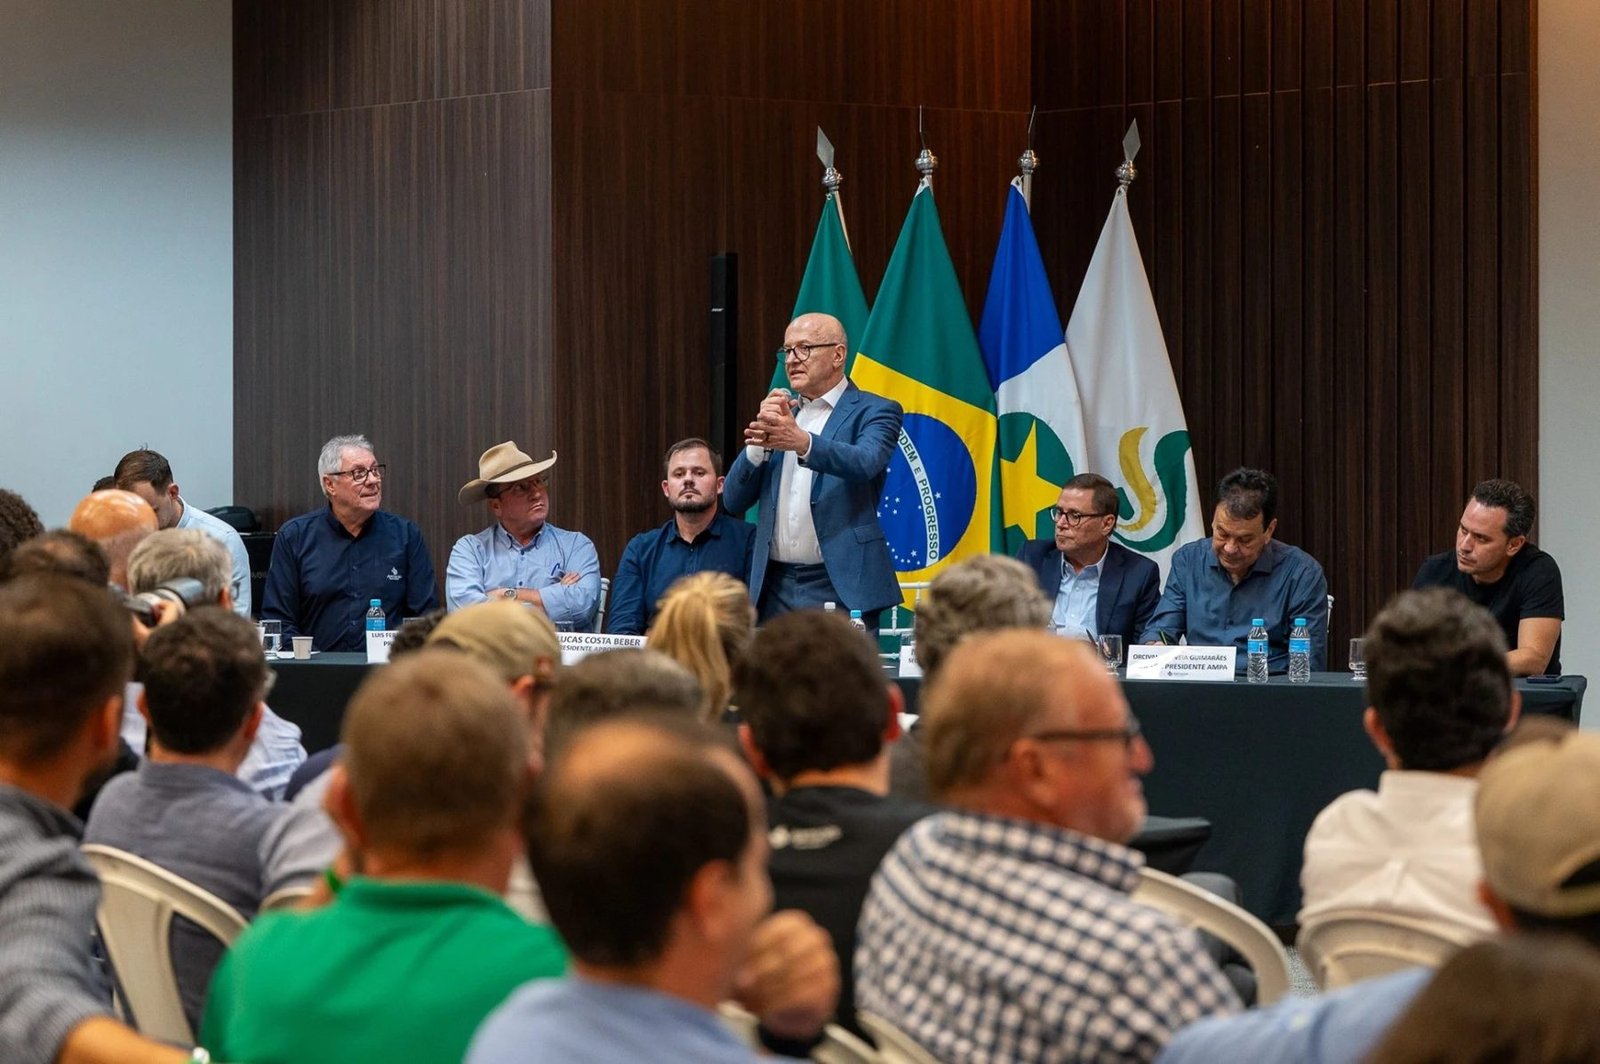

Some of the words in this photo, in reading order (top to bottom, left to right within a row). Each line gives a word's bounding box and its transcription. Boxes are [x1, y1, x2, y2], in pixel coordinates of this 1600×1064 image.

[913, 466, 922, 475] E
[918, 479, 938, 560] PROGRESSO
[584, 636, 612, 645] COSTA
[613, 637, 641, 646] BEBER
[559, 644, 592, 652] RESIDENTE
